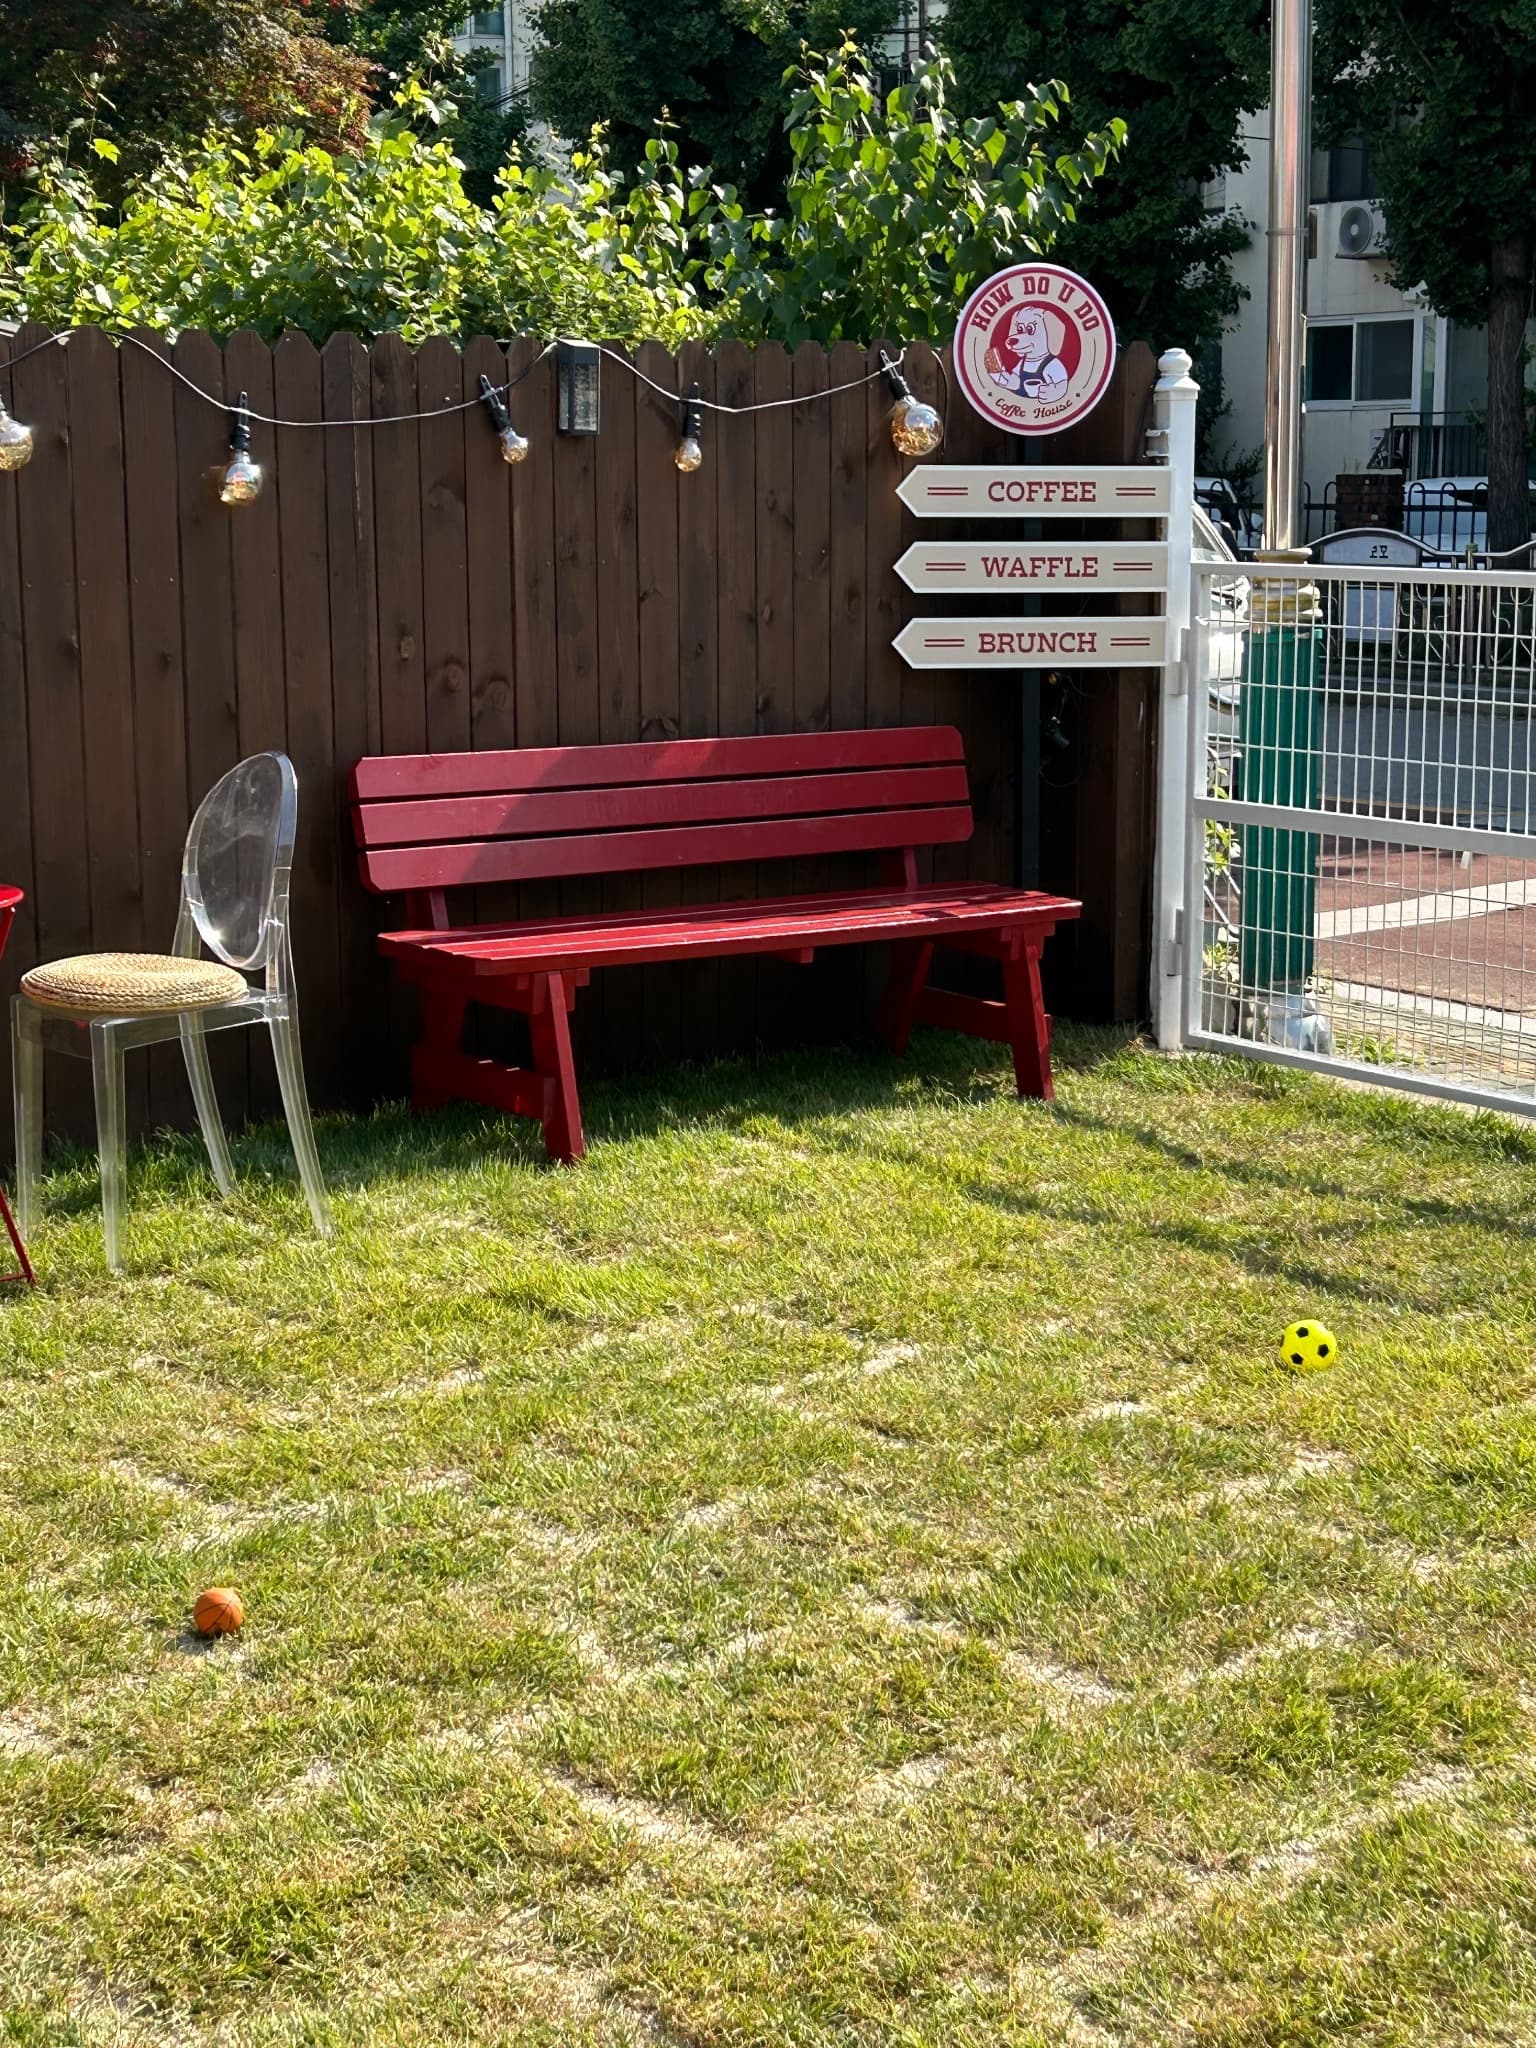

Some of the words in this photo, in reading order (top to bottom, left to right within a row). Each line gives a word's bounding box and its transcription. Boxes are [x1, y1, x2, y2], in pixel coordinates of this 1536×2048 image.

[969, 283, 1014, 332] HOW
[1022, 276, 1050, 295] DO
[1058, 282, 1076, 303] U
[1074, 301, 1100, 332] DO
[994, 398, 1026, 418] Coffee
[1033, 399, 1073, 419] House
[988, 481, 1096, 502] COFFEE
[981, 557, 1098, 578] WAFFLE
[978, 632, 1097, 653] BRUNCH
